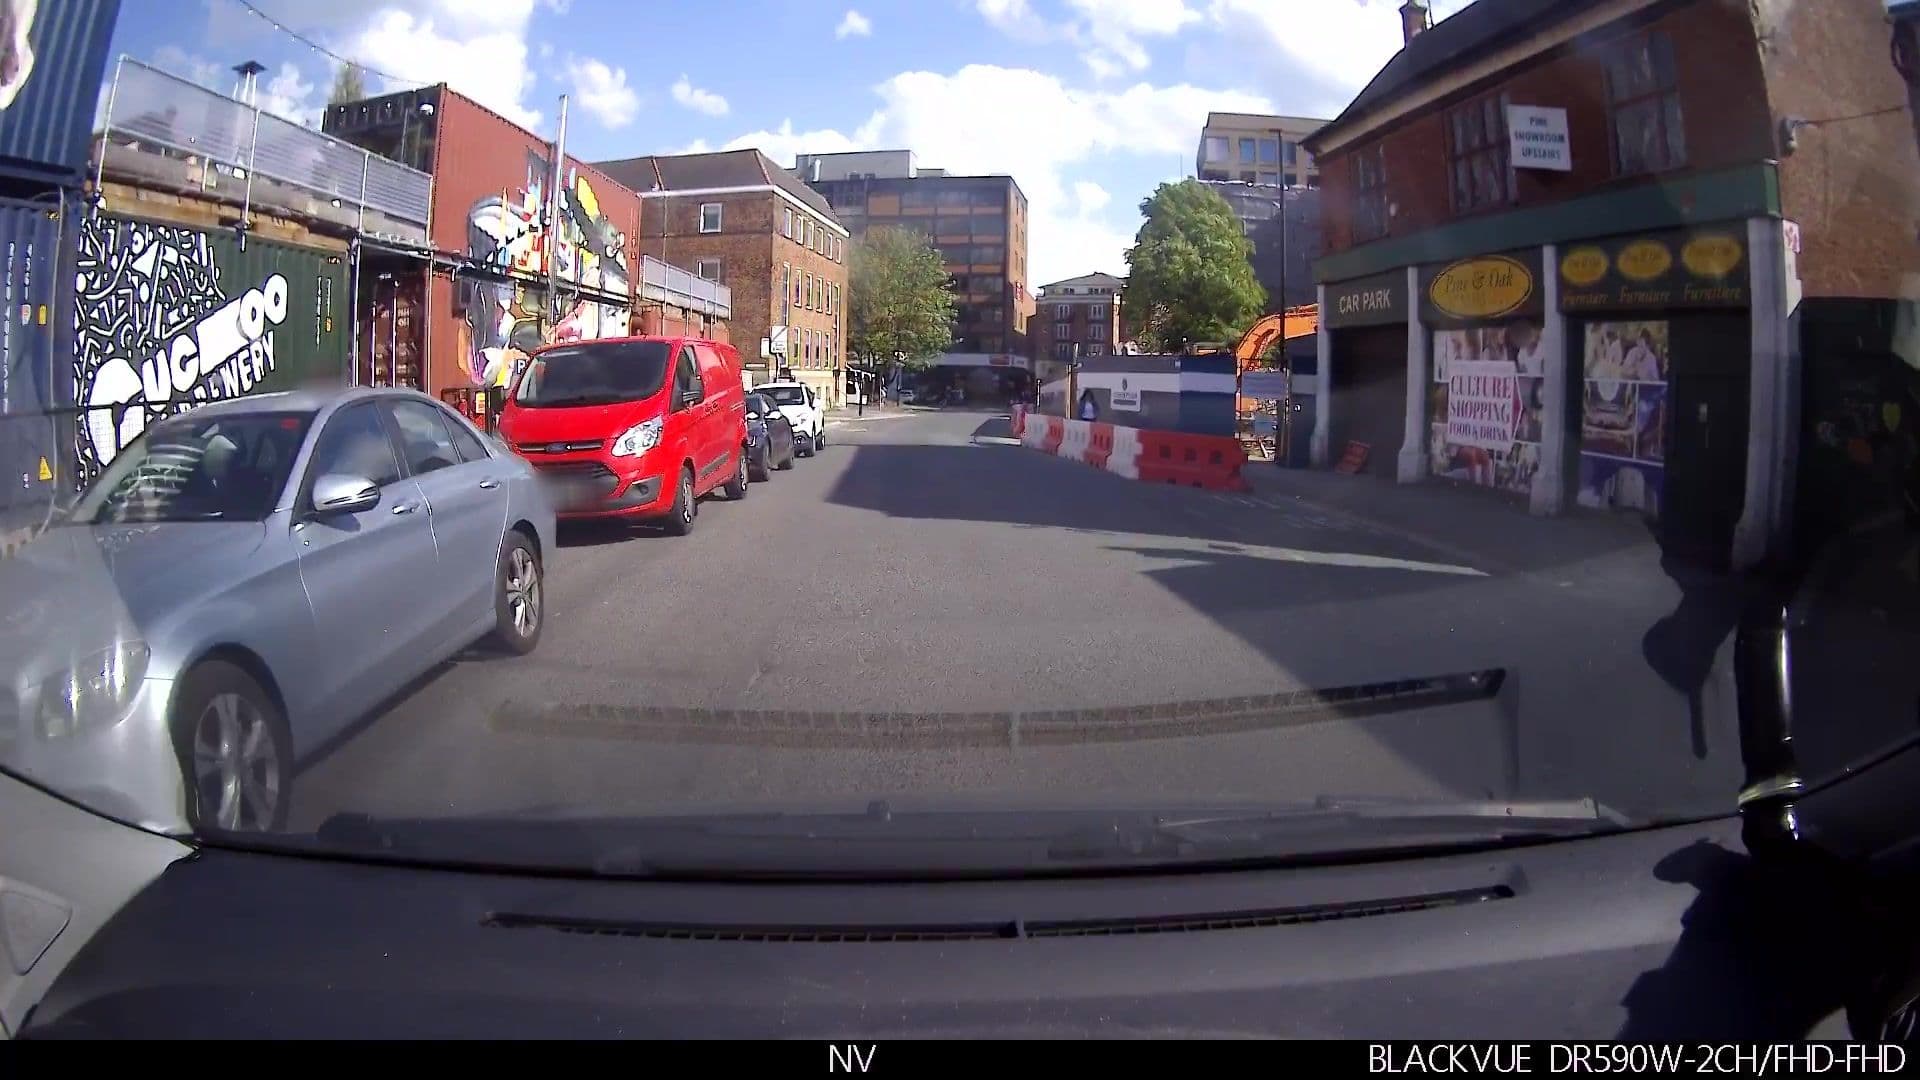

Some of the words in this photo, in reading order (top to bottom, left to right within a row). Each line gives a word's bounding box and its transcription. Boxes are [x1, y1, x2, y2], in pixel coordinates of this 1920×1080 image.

[1514, 131, 1565, 143] SHOWROOM
[1521, 147, 1560, 160] UPSTAIRS
[1339, 293, 1360, 313] CAR
[1362, 289, 1391, 311] PARK
[1451, 376, 1511, 399] CULTURE
[1450, 399, 1510, 424] SHOPPING
[1449, 422, 1471, 437] FOOD
[1480, 426, 1508, 441] DRINK
